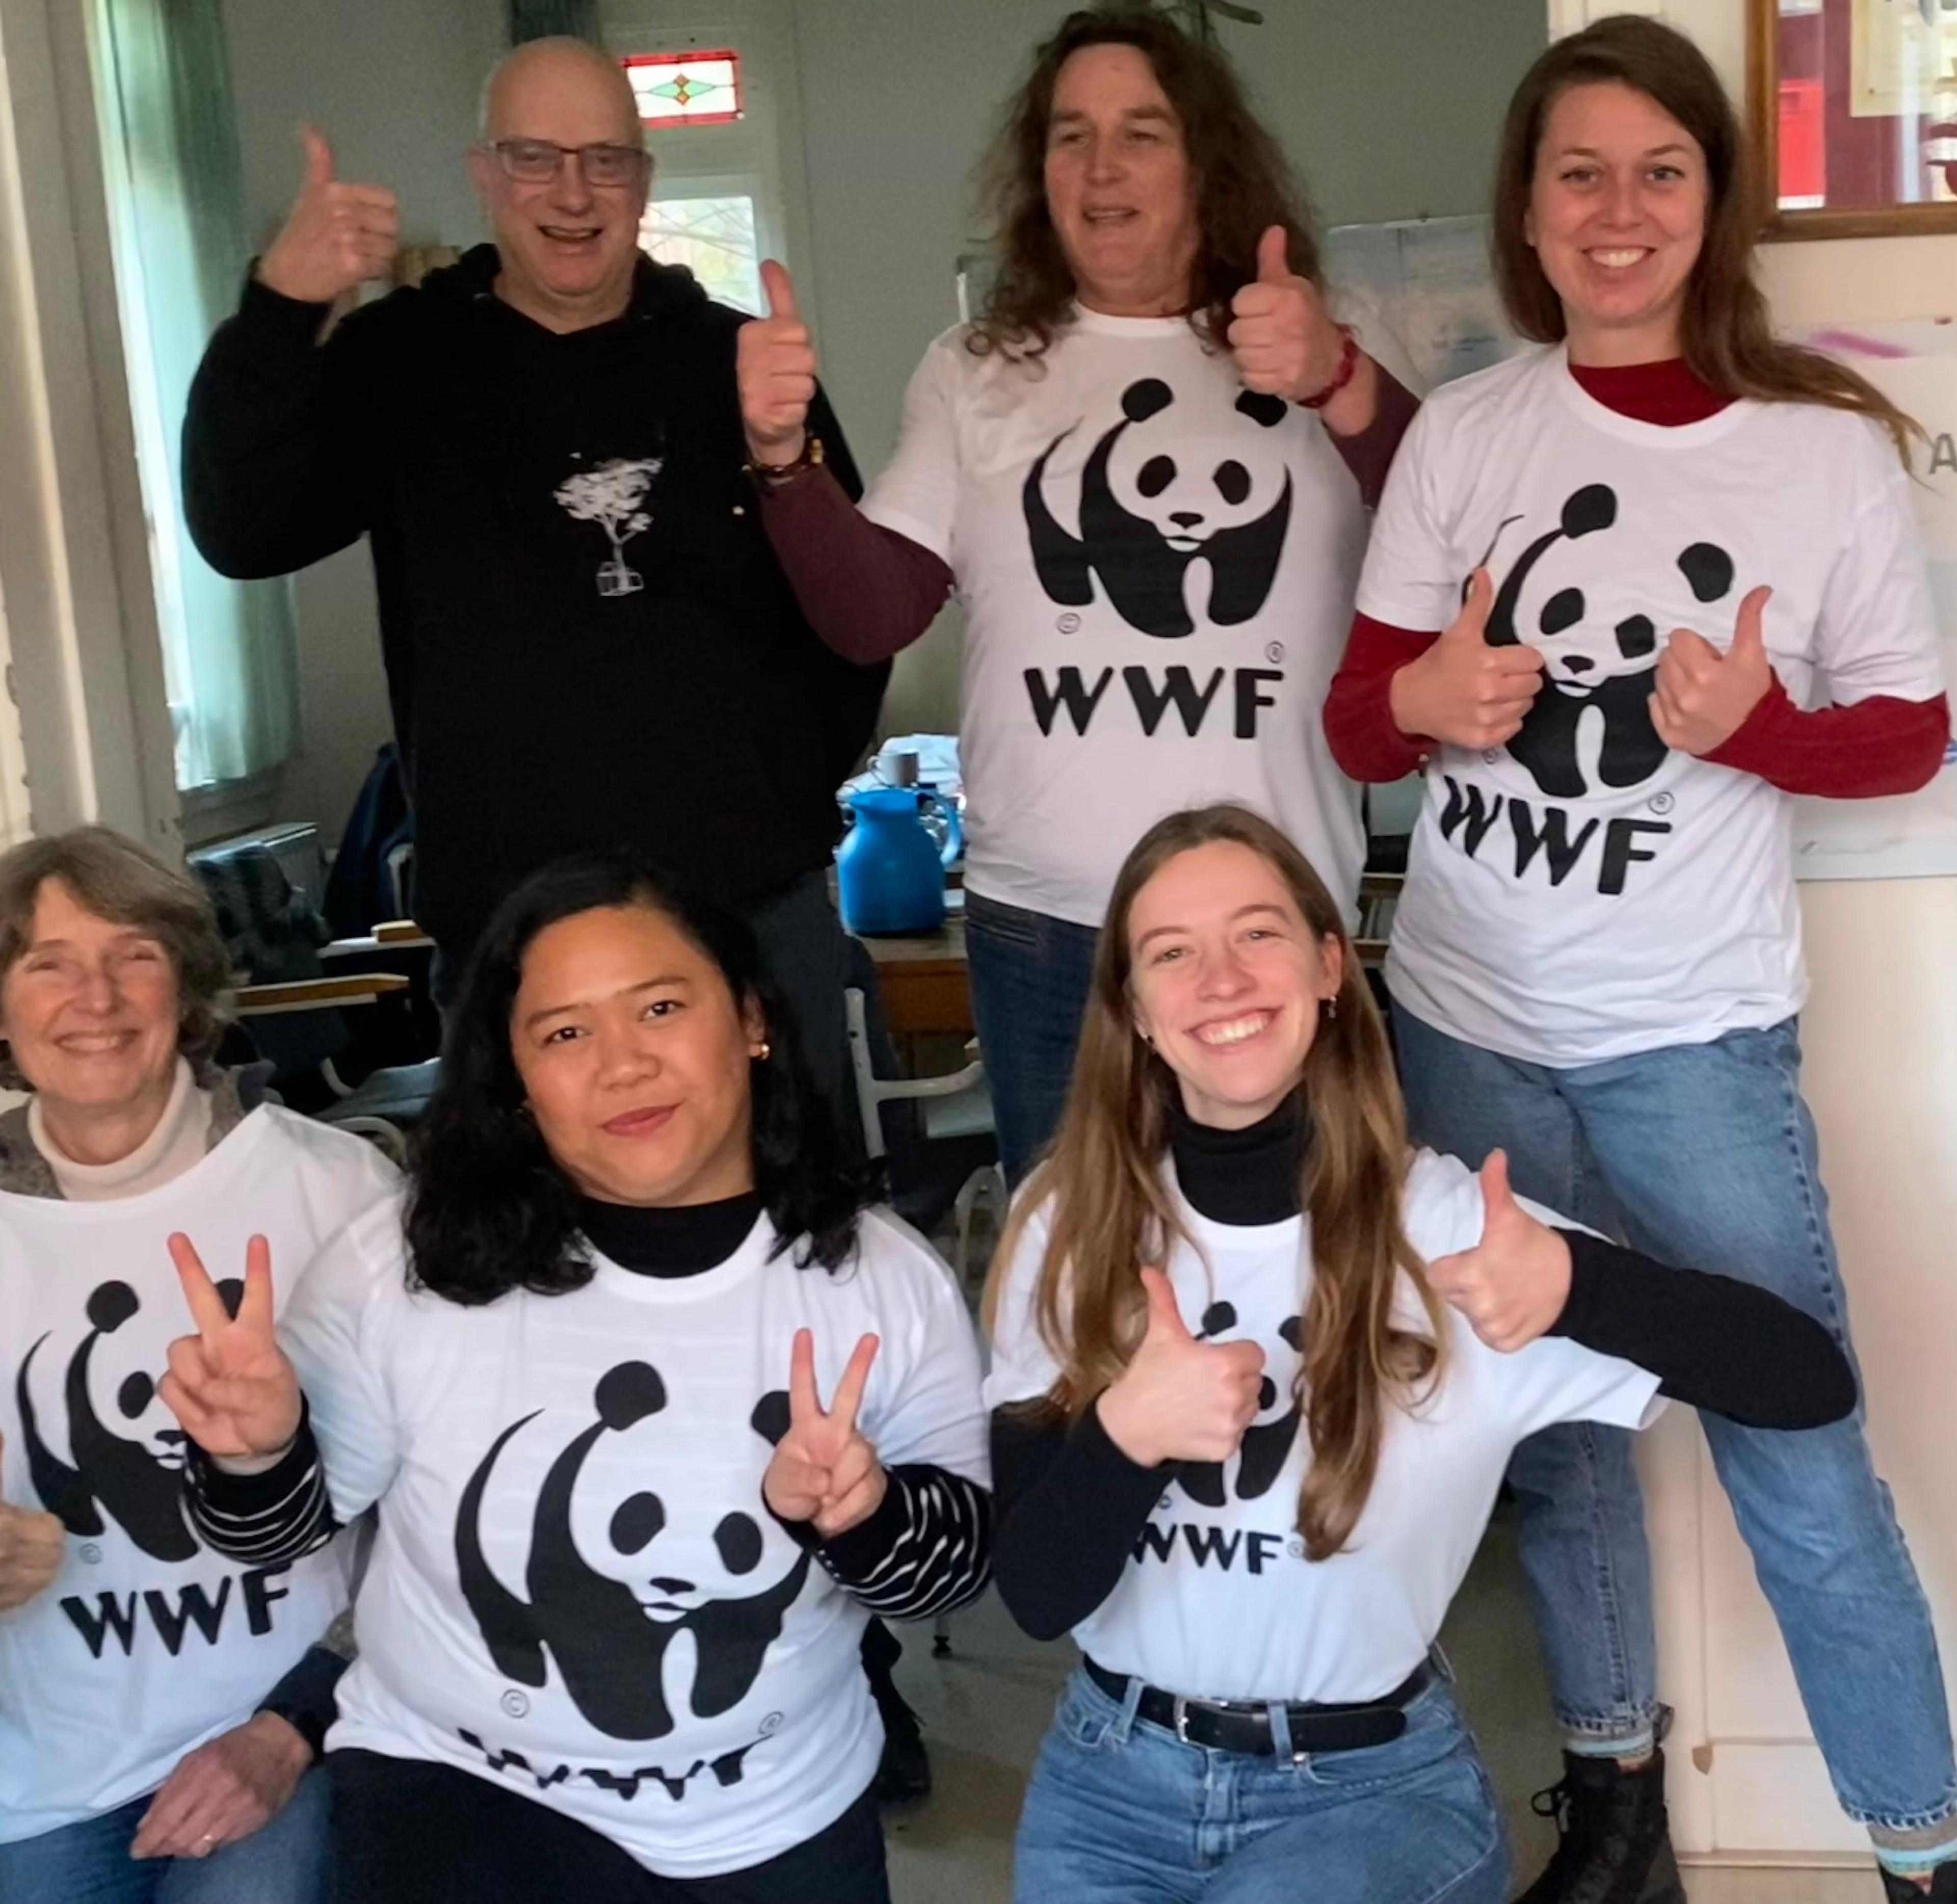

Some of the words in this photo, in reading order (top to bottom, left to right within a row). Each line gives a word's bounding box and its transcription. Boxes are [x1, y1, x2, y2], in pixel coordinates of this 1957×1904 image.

[1023, 665, 1284, 739] WWF
[1440, 775, 1672, 895] WWF
[1130, 1521, 1283, 1575] WWF
[59, 1562, 292, 1659] WWF
